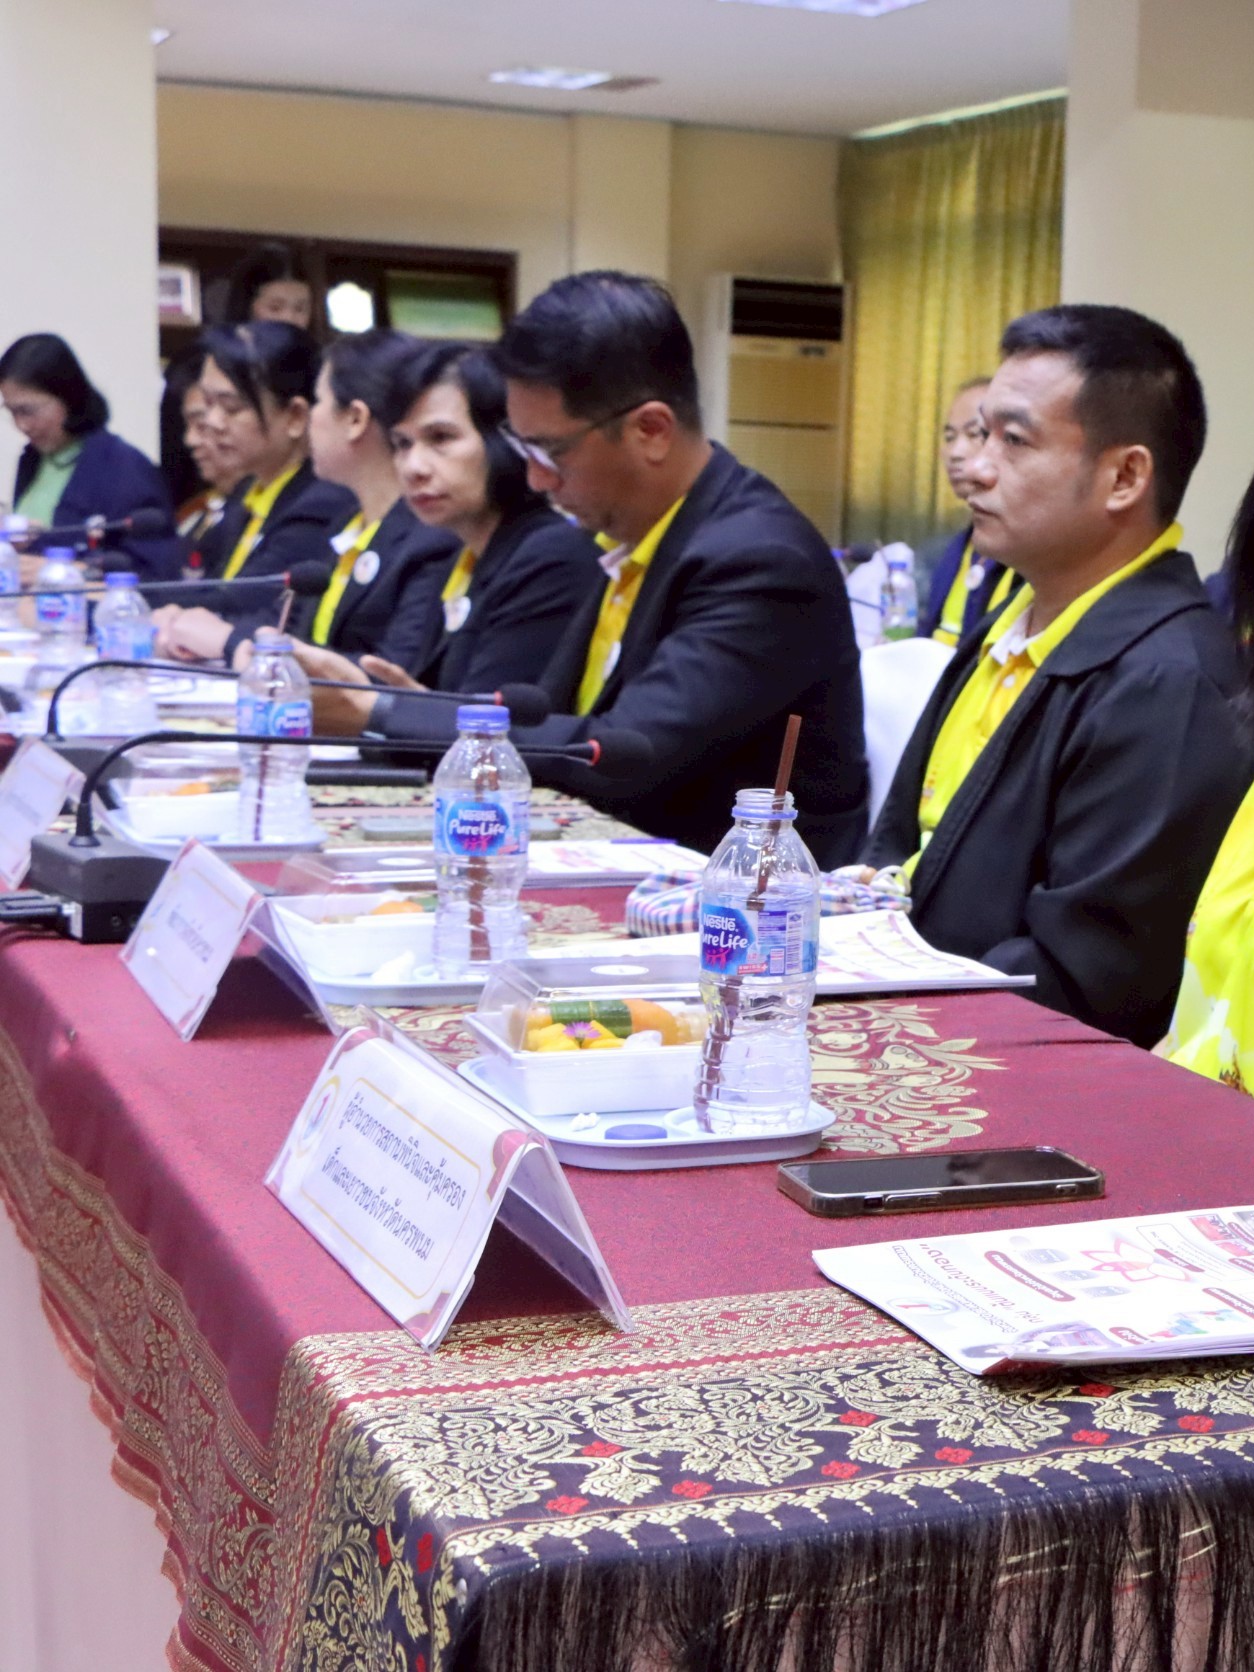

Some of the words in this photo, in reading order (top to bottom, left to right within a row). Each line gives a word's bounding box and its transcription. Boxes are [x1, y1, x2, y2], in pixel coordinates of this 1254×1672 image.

[321, 1146, 436, 1262] เด็กและเยาวชนจังหวัดนครพนม
[338, 1091, 467, 1212] ผู้อำนวยการสถานพินิจและคุ้มครอง
